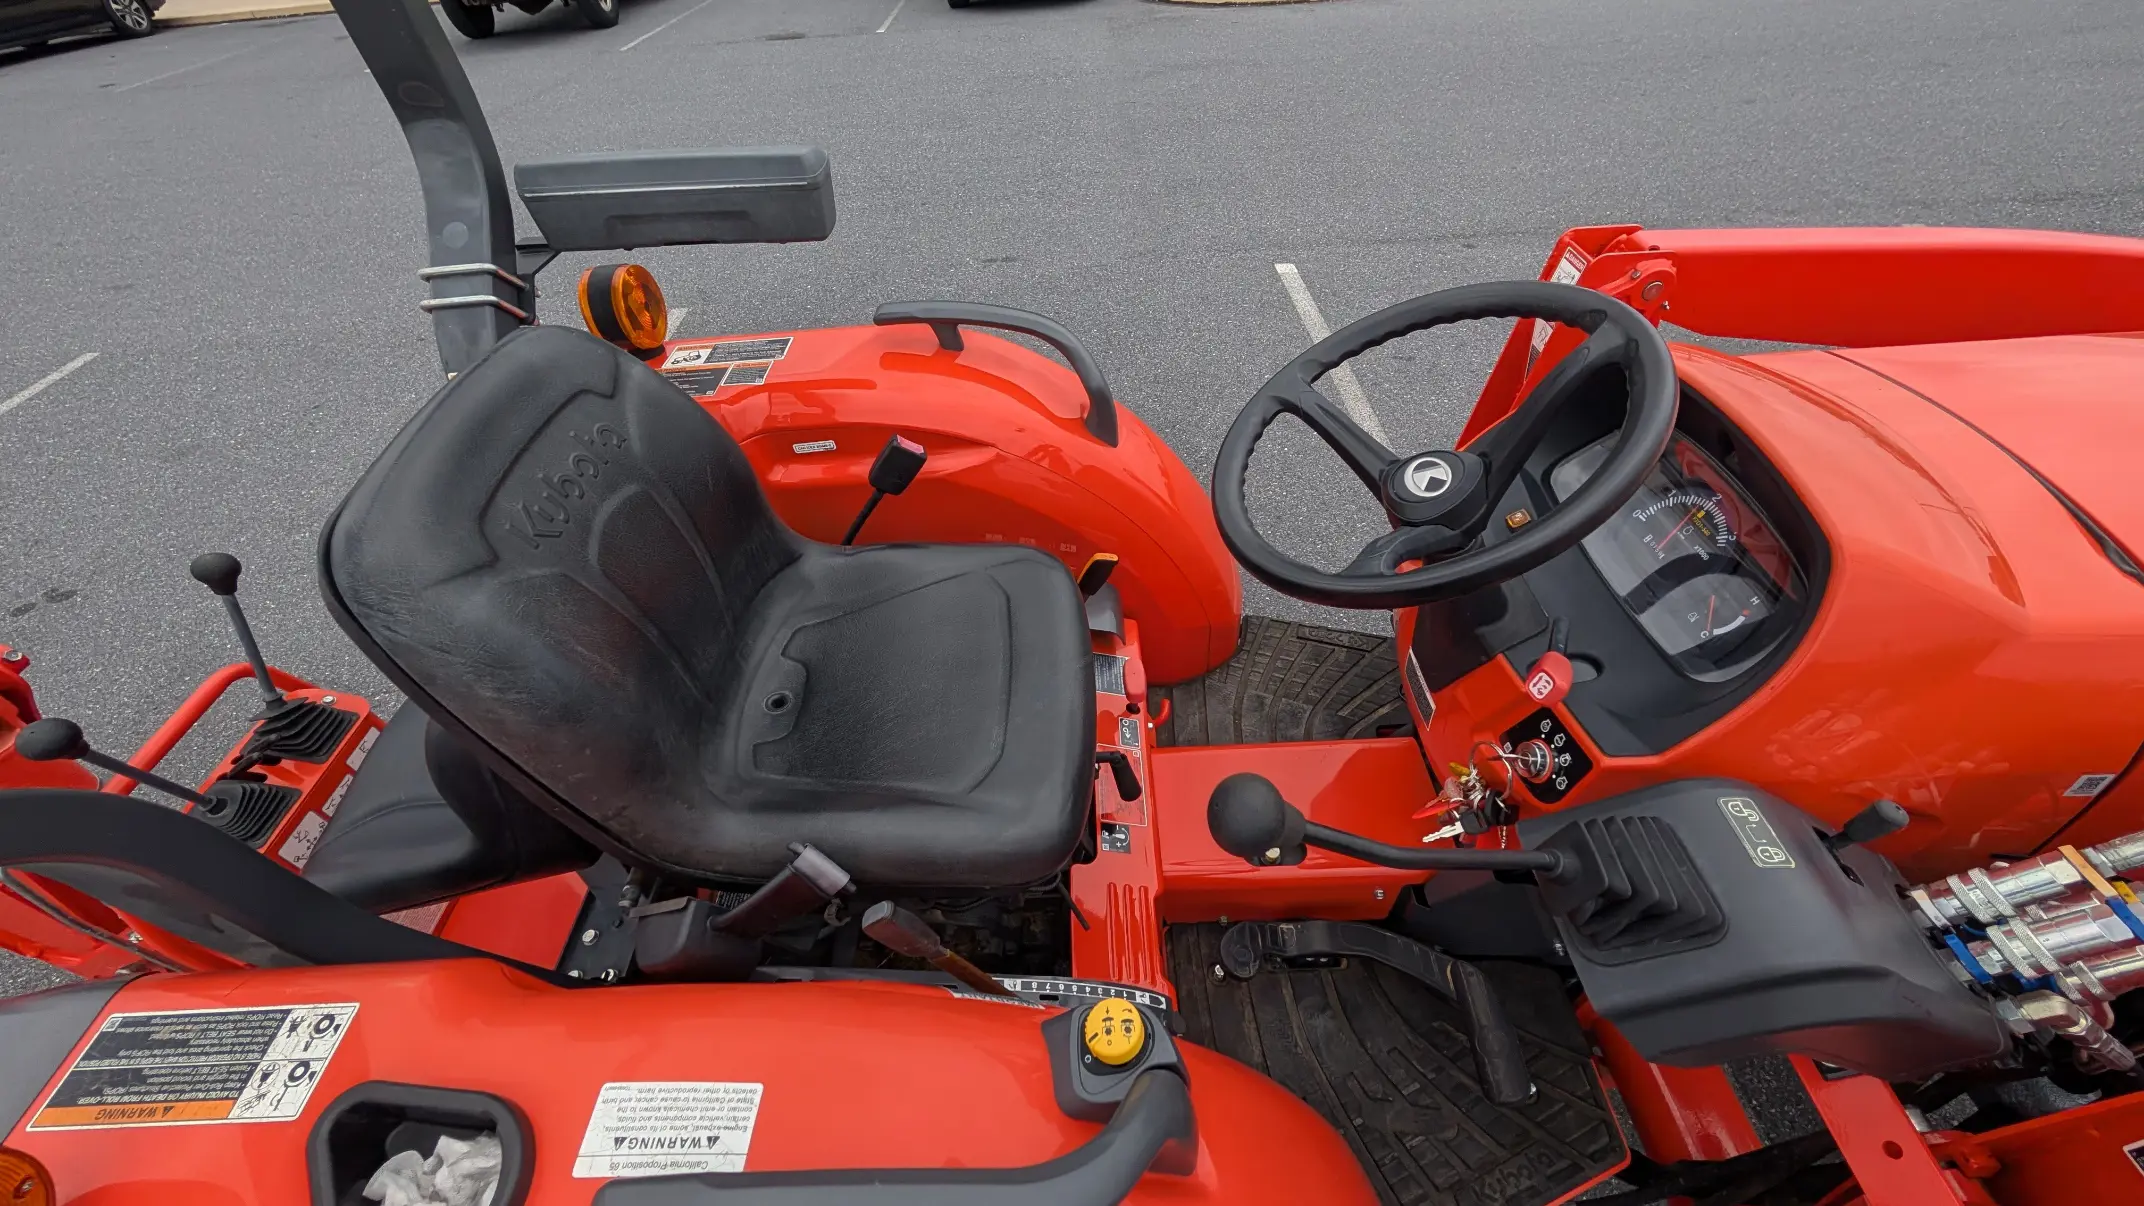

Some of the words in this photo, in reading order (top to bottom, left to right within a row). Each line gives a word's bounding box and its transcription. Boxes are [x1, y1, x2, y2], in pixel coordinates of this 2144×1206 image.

[502, 422, 627, 550] Kubota
[1668, 489, 1676, 498] 1
[1712, 493, 1722, 502] 2
[1633, 509, 1641, 517] 0
[1728, 531, 1737, 541] 3
[1750, 595, 1760, 605] H
[1700, 630, 1710, 640] C
[193, 1066, 211, 1074] BELT
[658, 1087, 701, 1095] reproductive
[121, 1094, 143, 1102] FROM
[143, 1093, 168, 1101] DEATH
[94, 1107, 158, 1120] WARNING
[654, 1114, 697, 1123] components
[725, 1124, 748, 1132] Engine
[627, 1136, 702, 1149] WARNING
[609, 1161, 620, 1171] 65
[622, 1160, 668, 1171] Proposition
[669, 1160, 709, 1170] California
[1471, 1151, 1556, 1203] Kubota
